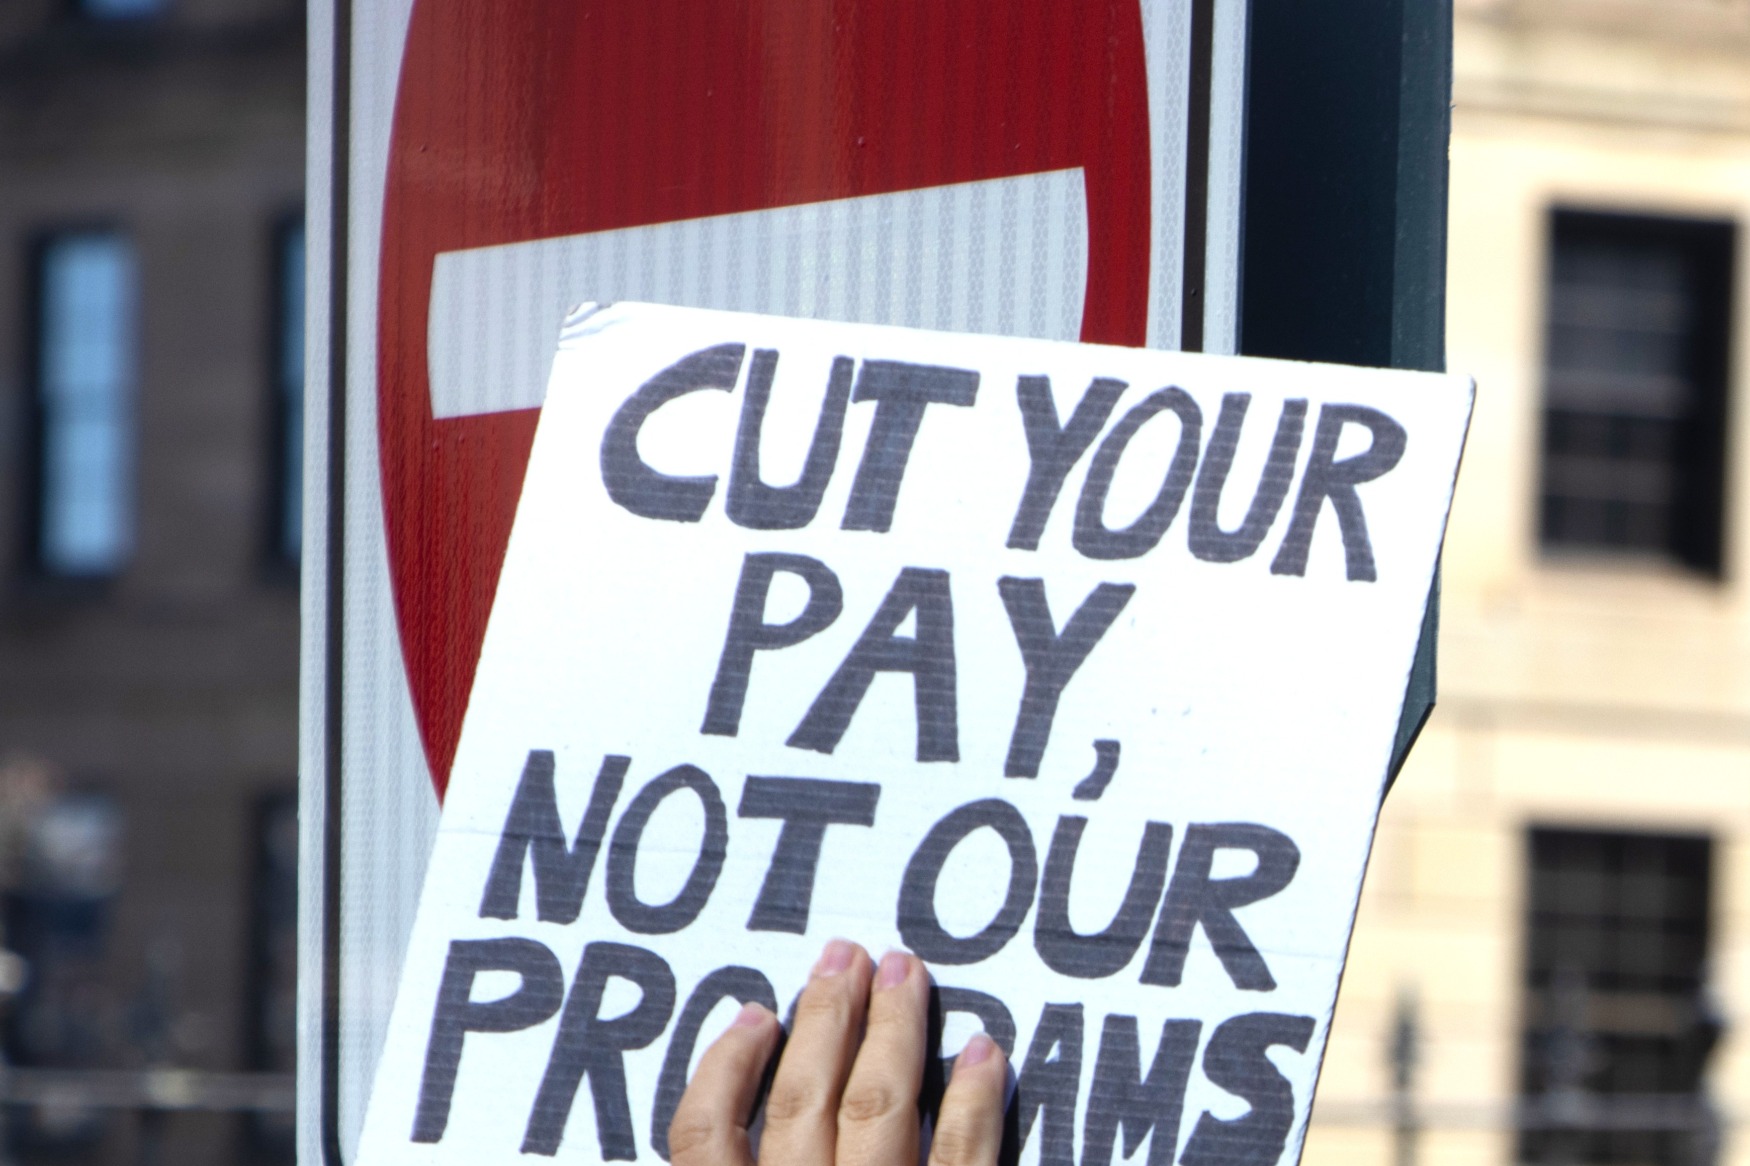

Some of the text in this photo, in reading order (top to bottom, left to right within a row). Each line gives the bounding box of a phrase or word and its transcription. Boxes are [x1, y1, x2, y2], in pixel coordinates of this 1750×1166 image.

[601, 343, 1407, 582] CUT YOUR
[700, 552, 1136, 800] PAY,
[479, 750, 1301, 992] NOT OUR
